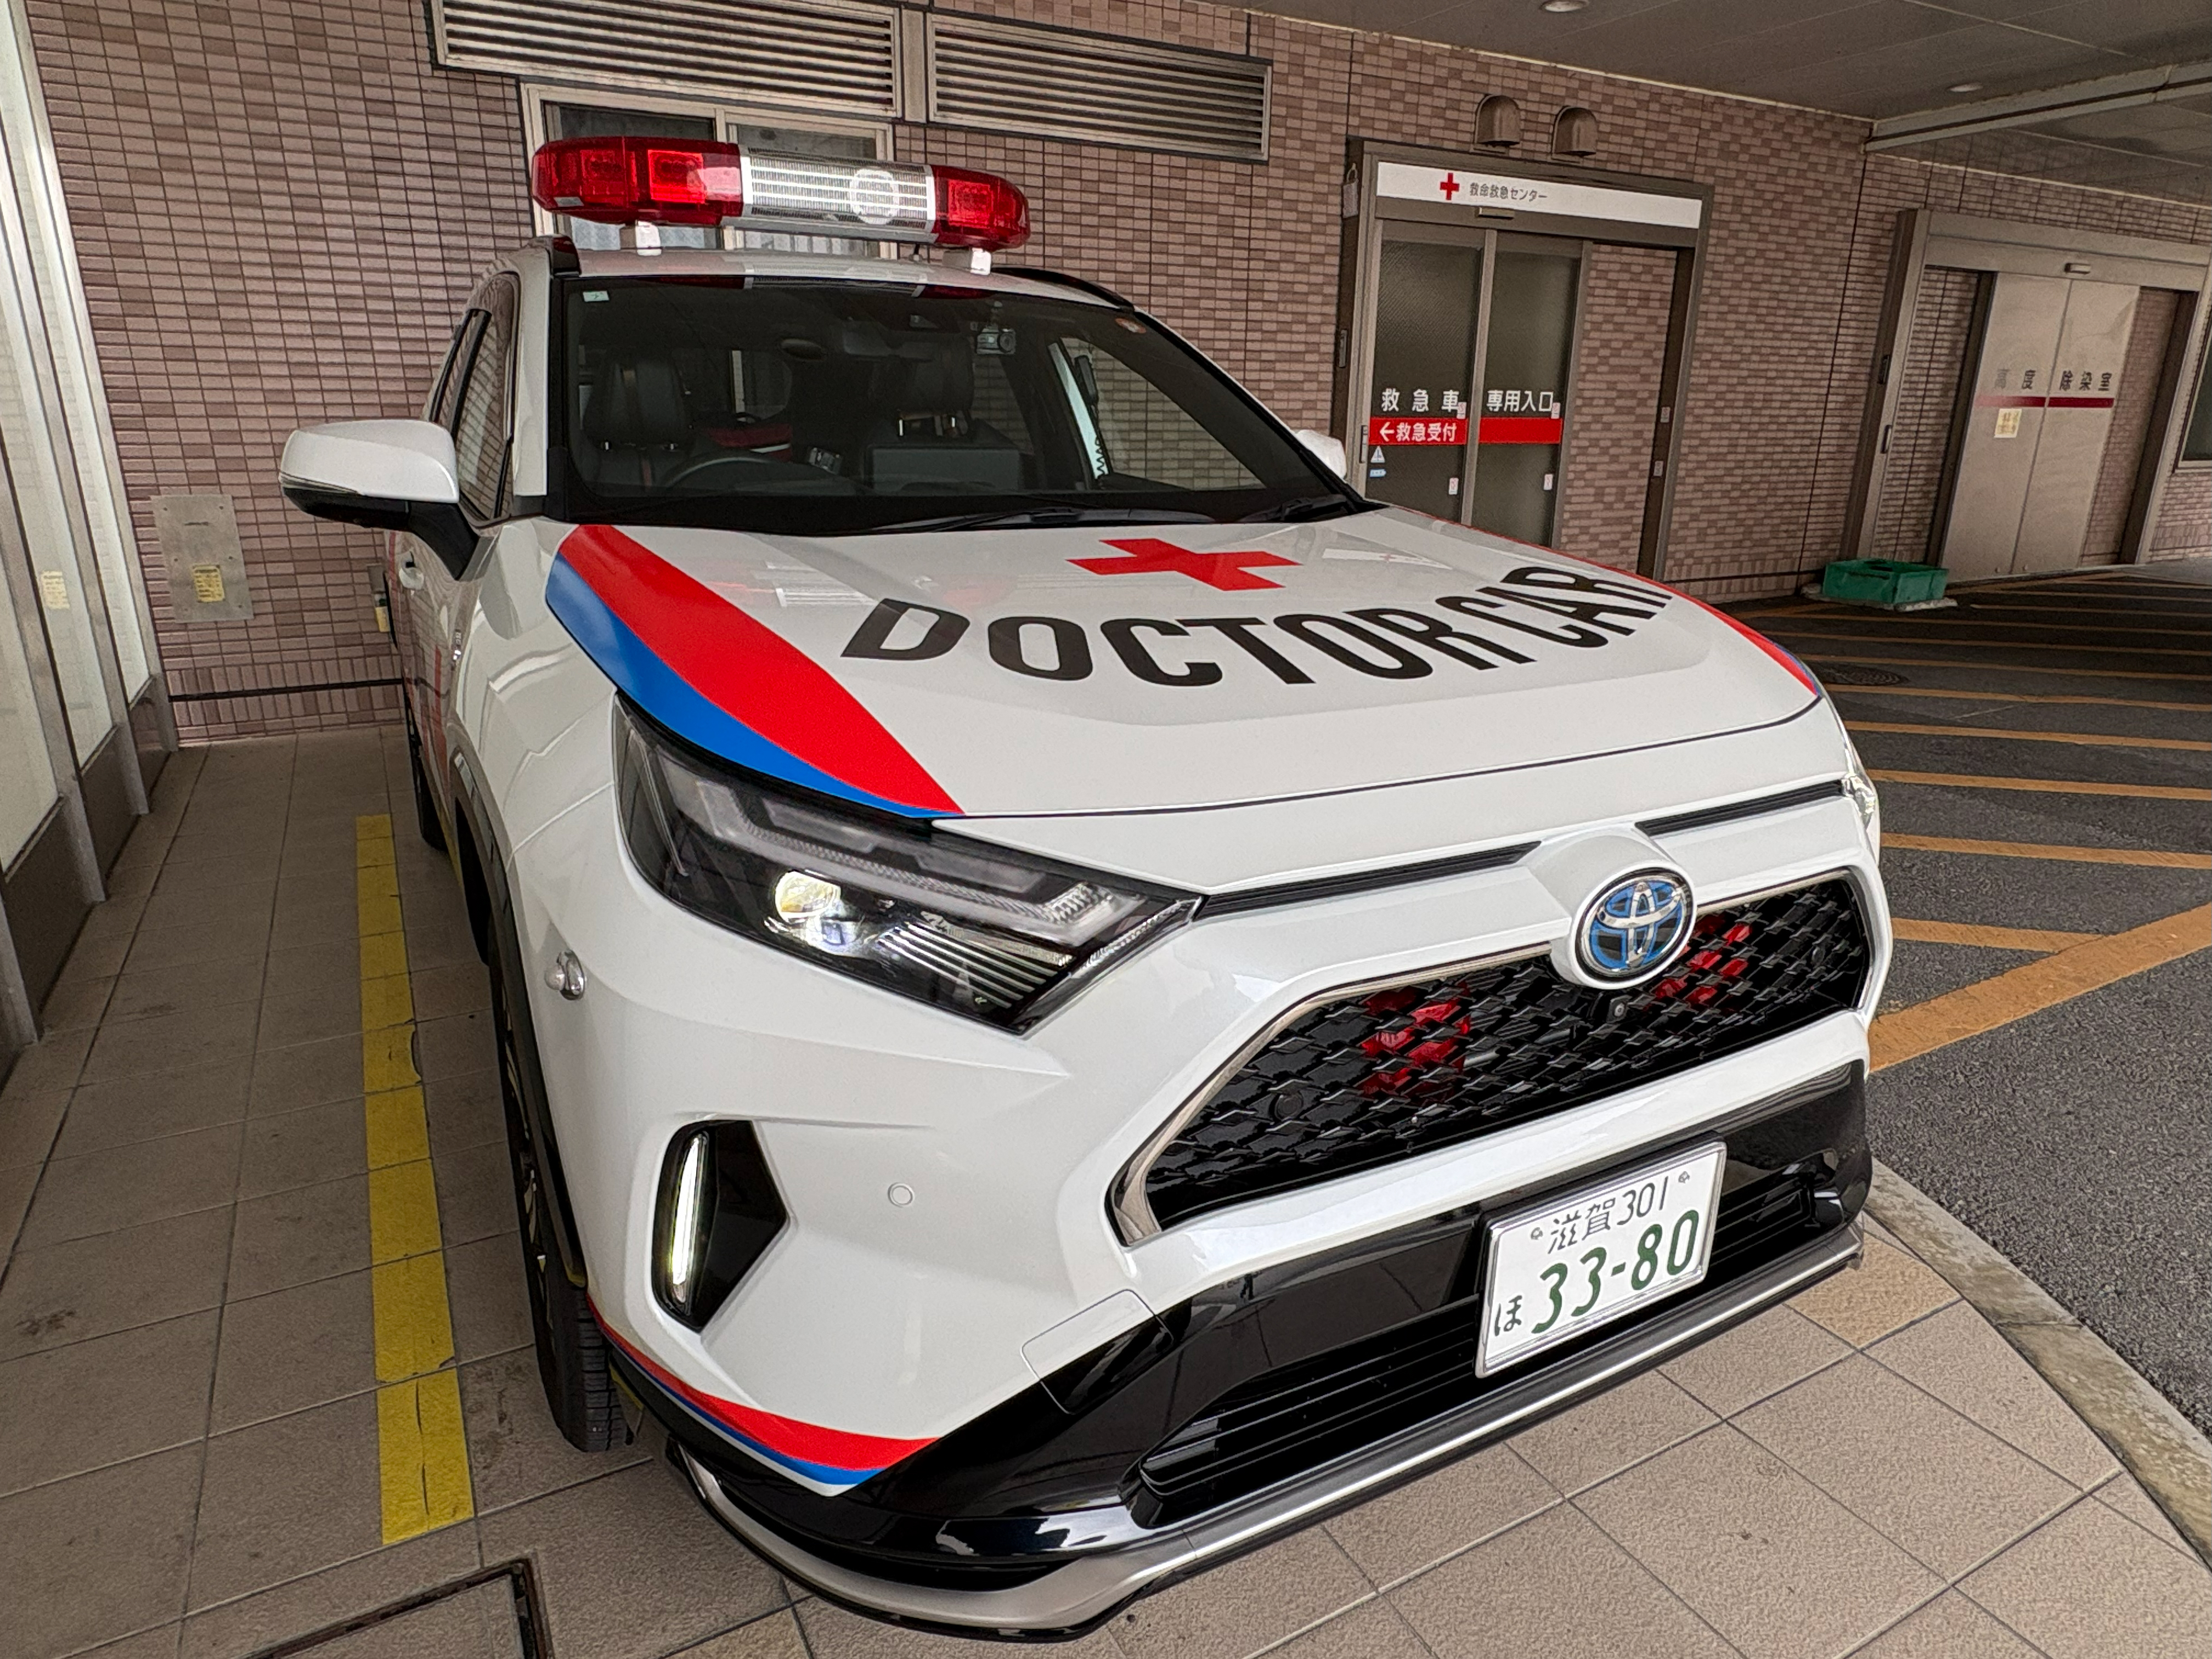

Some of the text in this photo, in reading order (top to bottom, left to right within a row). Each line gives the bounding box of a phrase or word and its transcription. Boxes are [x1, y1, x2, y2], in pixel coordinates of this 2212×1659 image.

[1469, 182, 1548, 202] 救命救急センター
[2059, 370, 2112, 392] 除染室
[1381, 388, 1554, 413] 救急車 専用入口
[1396, 422, 1457, 442] 救急受付
[840, 566, 1673, 687] DOCTOR CAR
[1548, 1176, 1669, 1254] 滋賀 301
[1493, 1210, 1700, 1336] ほ 33-80
